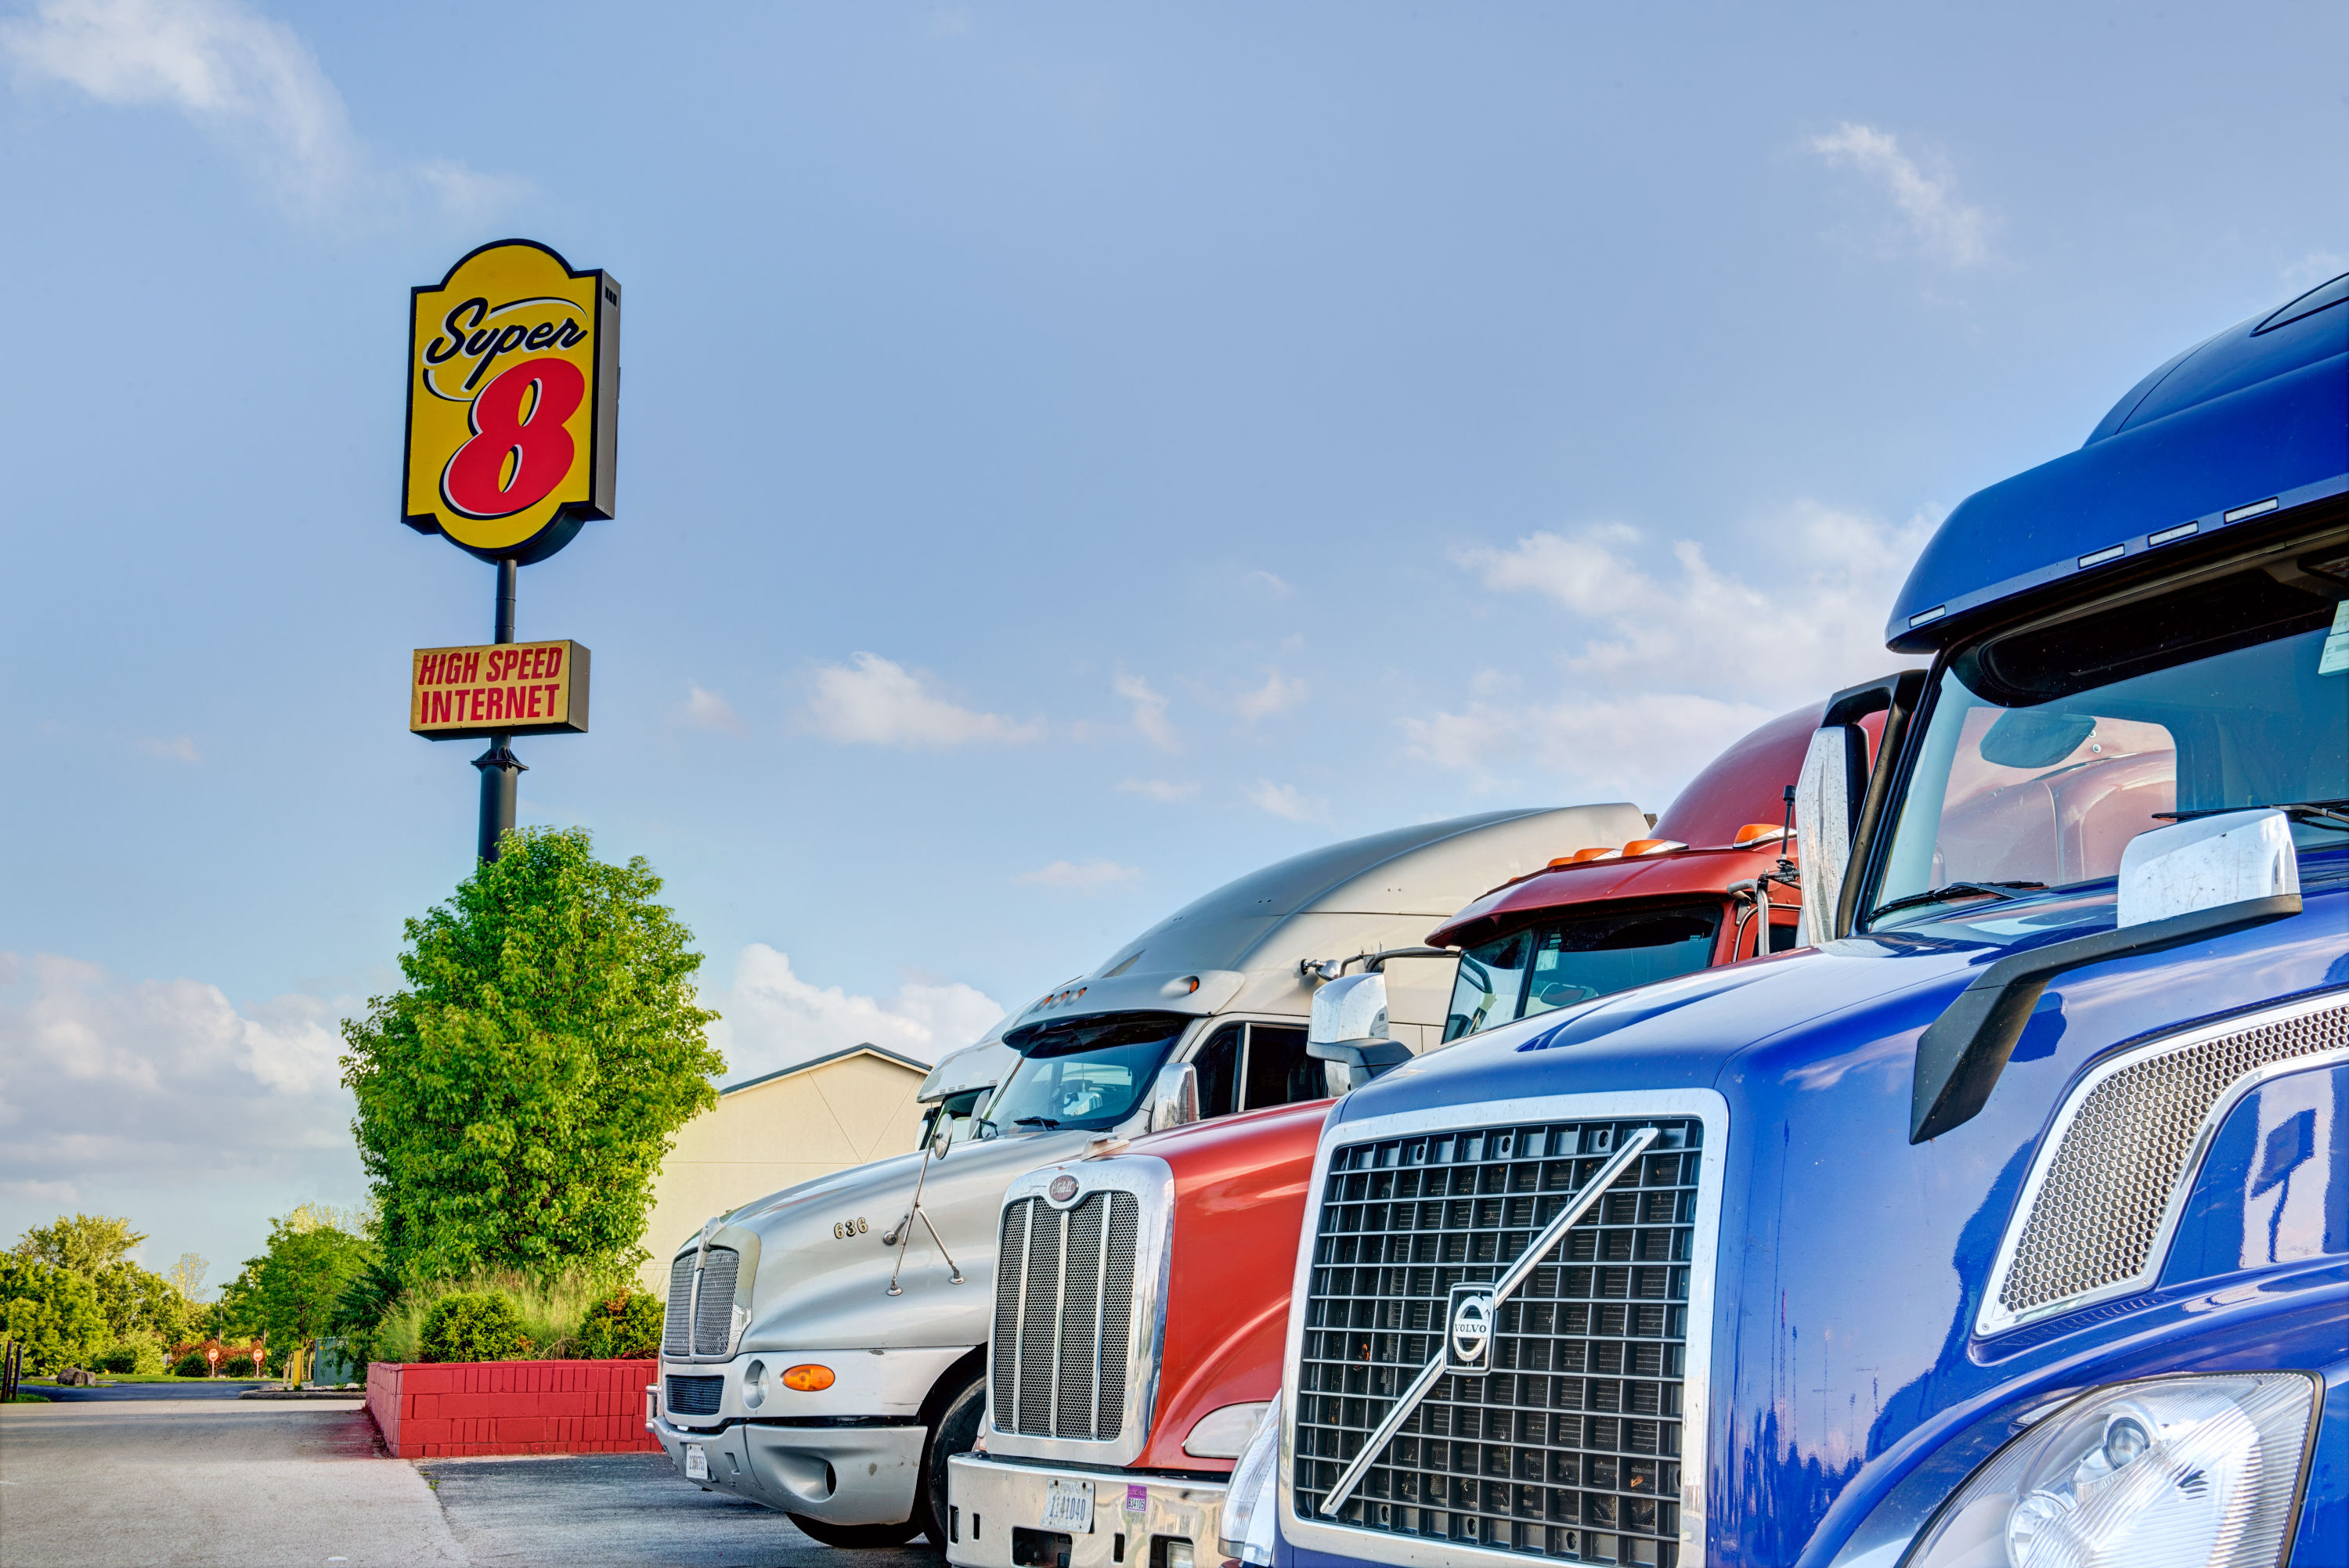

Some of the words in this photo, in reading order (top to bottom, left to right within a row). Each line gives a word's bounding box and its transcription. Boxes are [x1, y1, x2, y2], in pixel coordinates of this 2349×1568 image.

[422, 297, 588, 392] Super
[439, 358, 585, 521] 8
[418, 651, 480, 686] HIGH
[485, 647, 563, 682] SPEED
[420, 683, 560, 724] INTERNET
[833, 1217, 869, 1240] 636
[1454, 1324, 1487, 1333] VOLVO
[1048, 1494, 1086, 1521] 1141040
